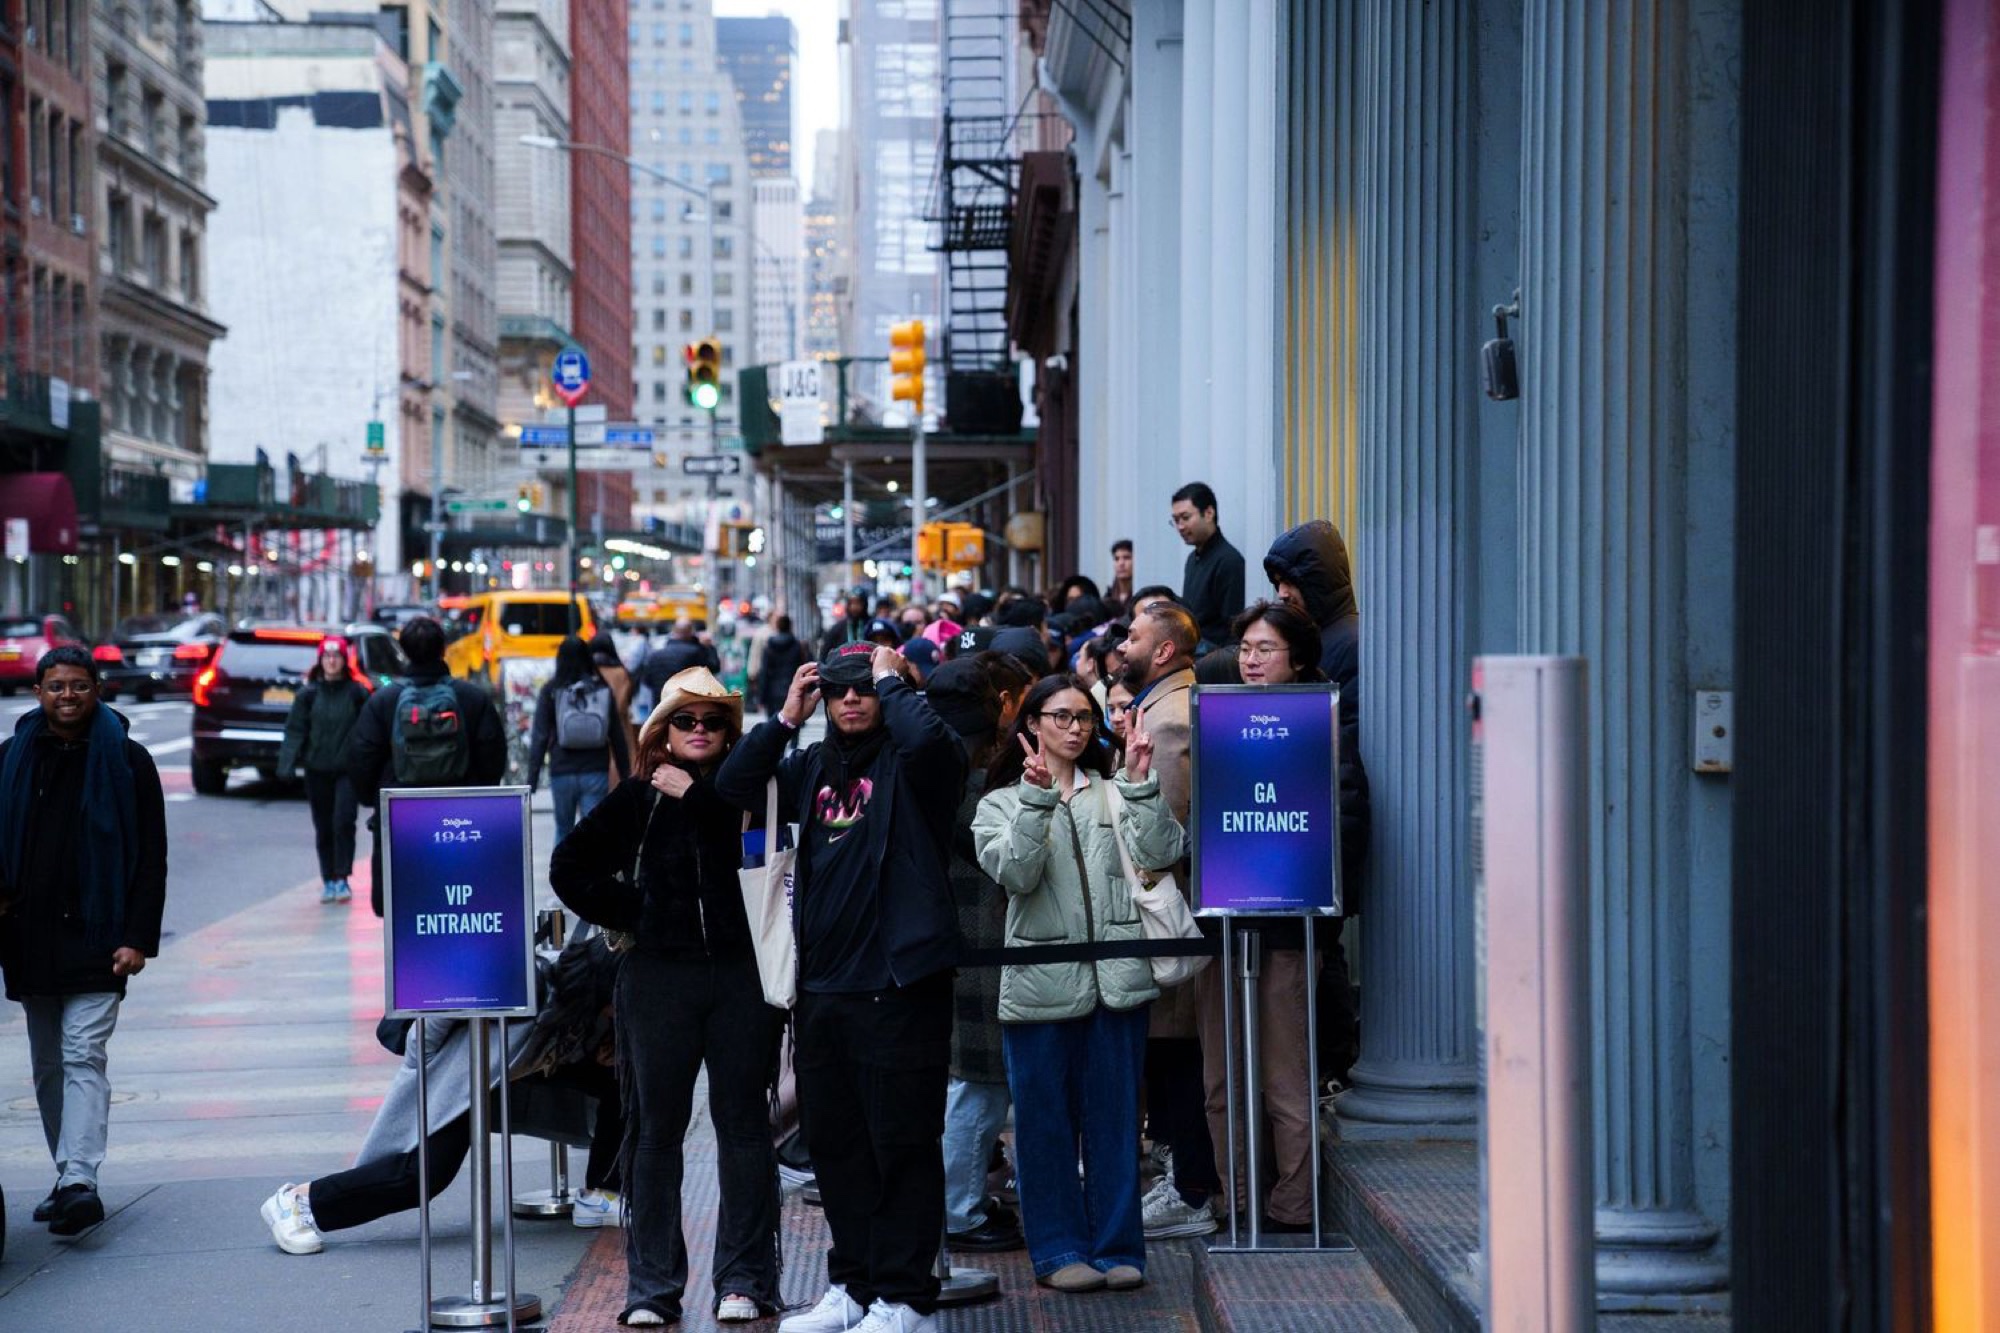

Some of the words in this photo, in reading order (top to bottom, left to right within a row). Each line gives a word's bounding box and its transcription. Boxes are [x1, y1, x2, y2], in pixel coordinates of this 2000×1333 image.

[1254, 782, 1277, 804] GA
[1222, 811, 1309, 833] ENTRANCE
[444, 884, 473, 906] VIP
[416, 912, 503, 935] ENTRANCE
